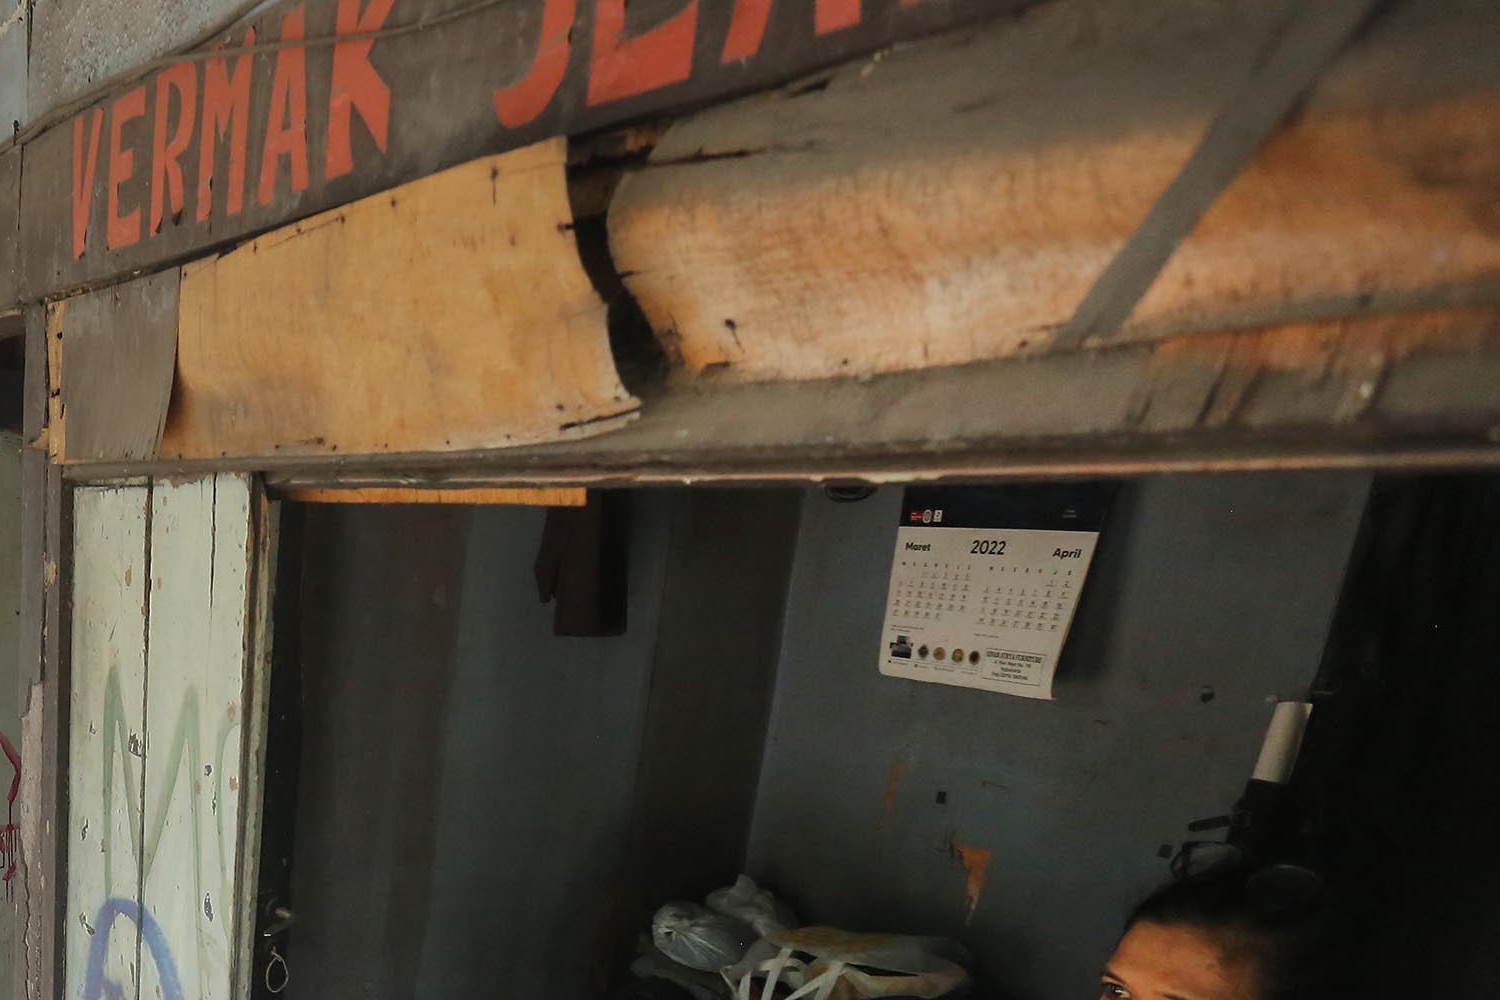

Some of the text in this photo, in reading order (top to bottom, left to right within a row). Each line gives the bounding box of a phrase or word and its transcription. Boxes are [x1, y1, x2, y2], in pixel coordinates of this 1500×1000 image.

[72, 0, 393, 259] VERMAK
[905, 540, 1082, 560] Maret 2022 April
